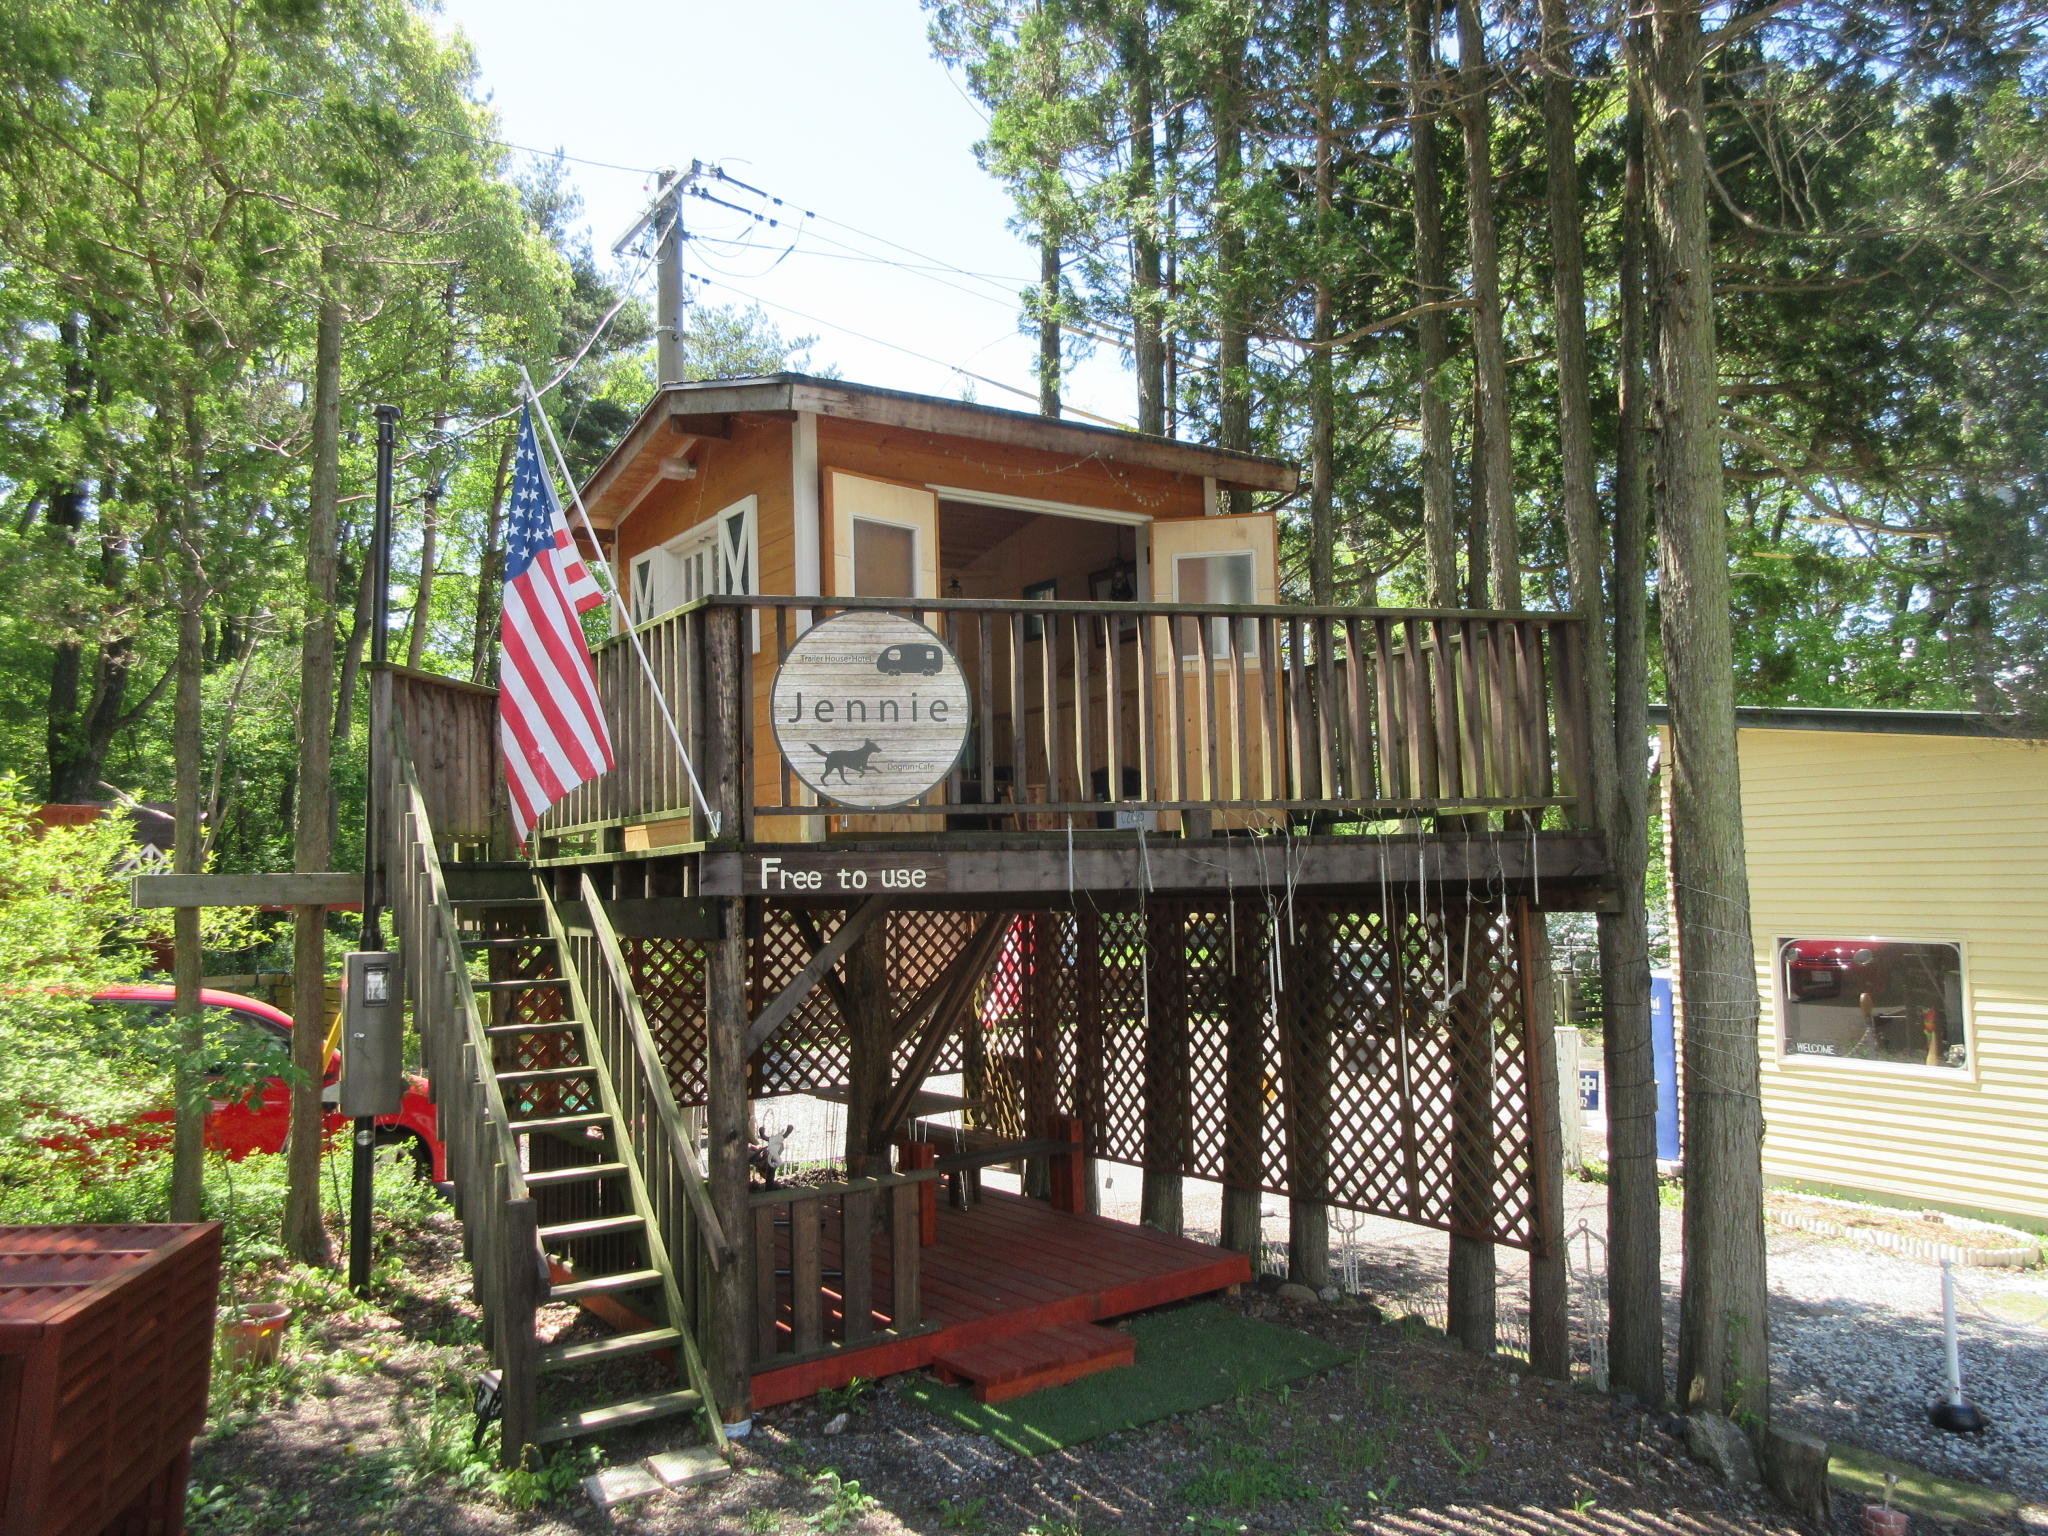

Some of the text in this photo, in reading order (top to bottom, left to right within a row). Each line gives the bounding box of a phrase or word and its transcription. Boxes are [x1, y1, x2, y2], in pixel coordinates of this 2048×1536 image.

[801, 654, 823, 663] Trailer
[788, 692, 949, 723] Jennie
[760, 857, 927, 890] Free to use
[1796, 1042, 1836, 1055] WELCOME
